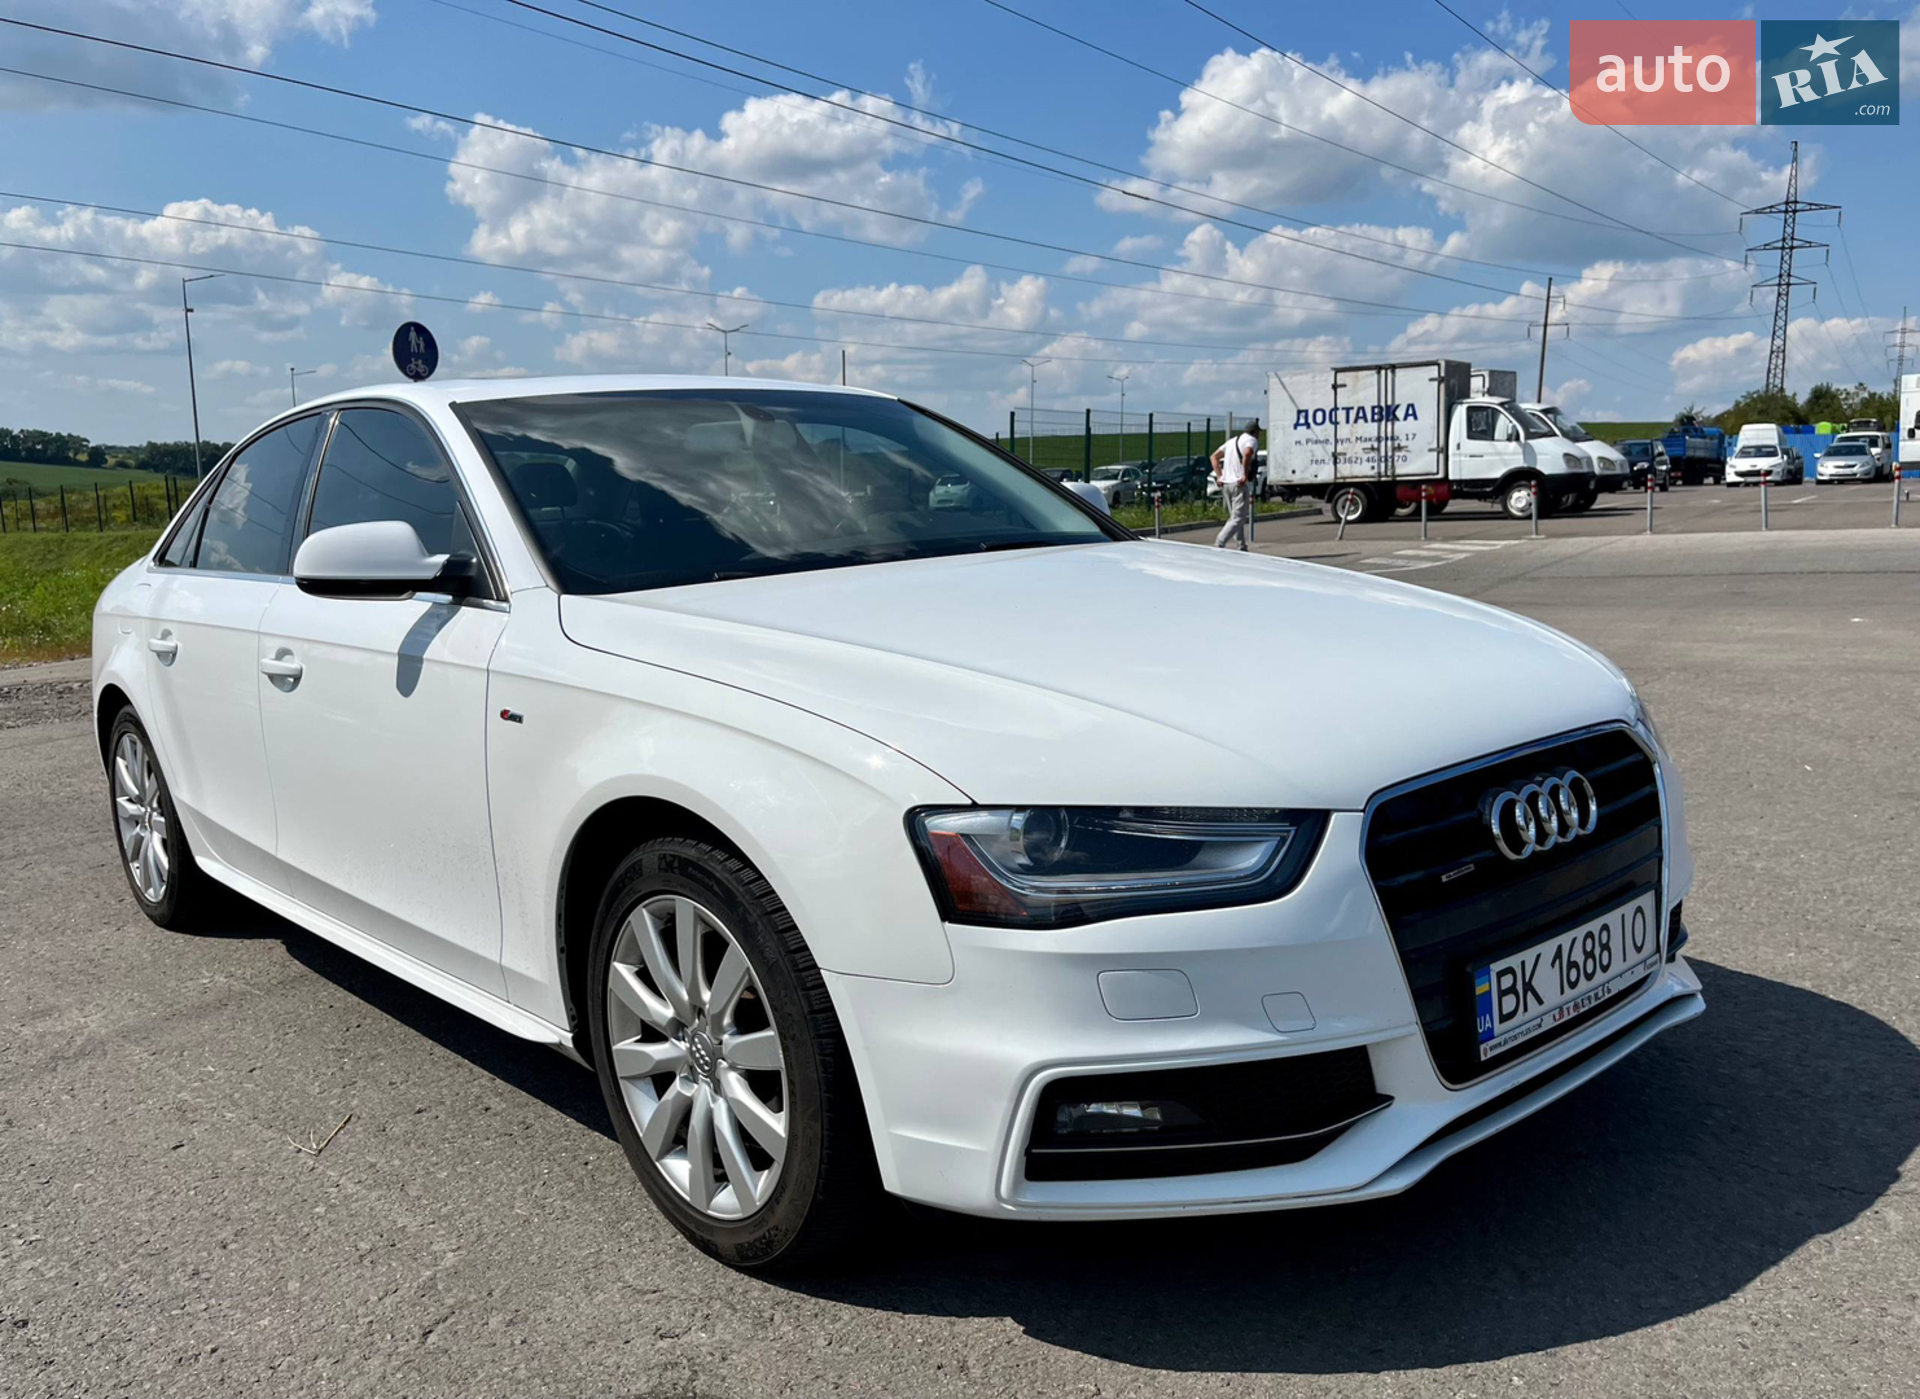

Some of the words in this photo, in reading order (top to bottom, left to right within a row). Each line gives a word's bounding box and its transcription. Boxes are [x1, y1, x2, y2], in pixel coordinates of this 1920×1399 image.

[1293, 403, 1419, 430] ДОСТАВКА
[1404, 432, 1417, 442] 17
[1495, 952, 1544, 1024] BK
[1550, 922, 1612, 996] 1688
[1477, 1013, 1492, 1033] UA
